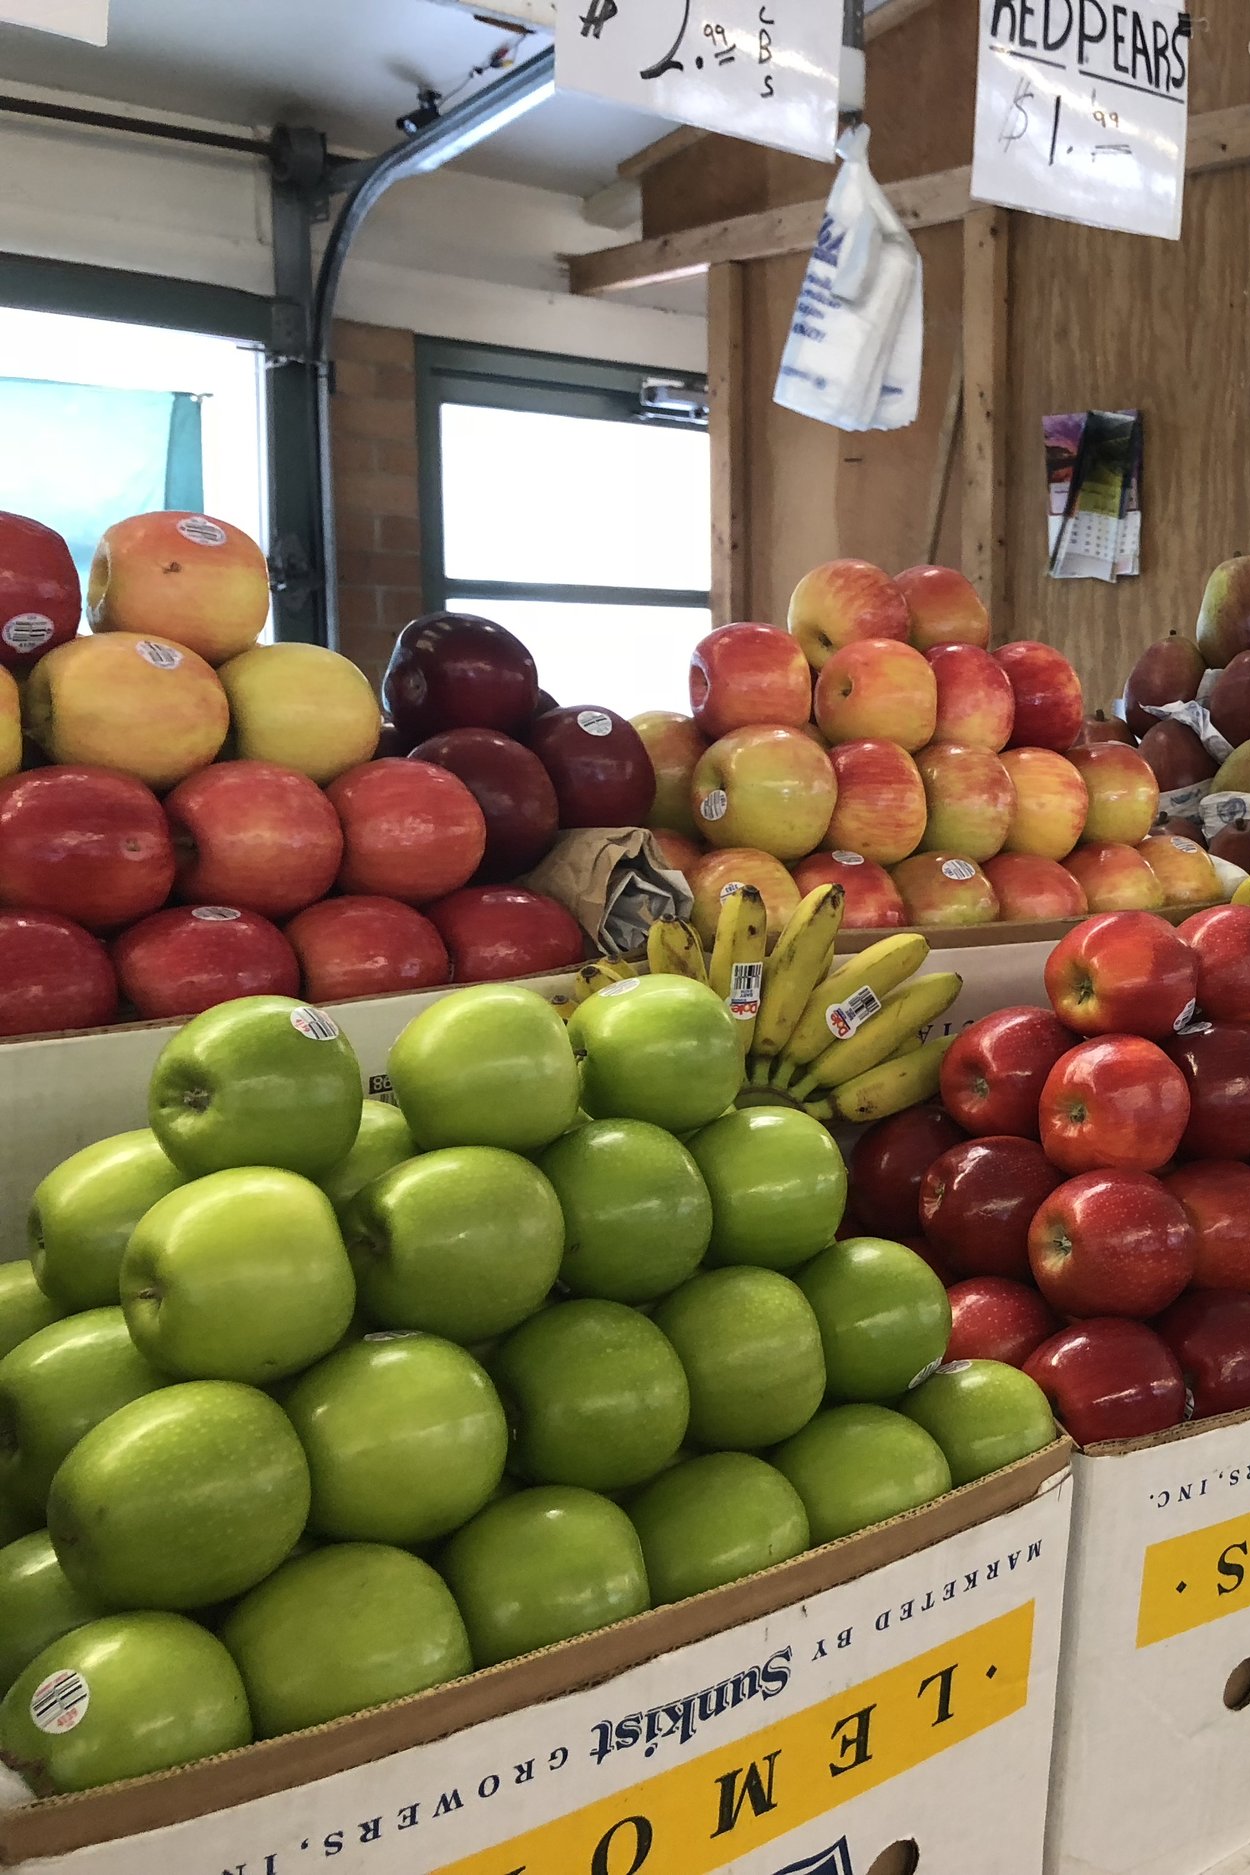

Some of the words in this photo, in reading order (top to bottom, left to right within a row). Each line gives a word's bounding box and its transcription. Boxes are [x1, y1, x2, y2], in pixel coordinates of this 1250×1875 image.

[987, 0, 1073, 51] RED
[1077, 0, 1187, 92] PEARS
[730, 999, 759, 1019] Dole
[830, 1012, 851, 1039] Dole
[1148, 1478, 1208, 1509] INC.
[876, 1539, 1045, 1633] MARKETED
[811, 1626, 855, 1662] BY
[590, 1644, 793, 1764] Sunkist
[301, 1745, 570, 1856] GROWERS,
[506, 1663, 957, 1875] LEMO
